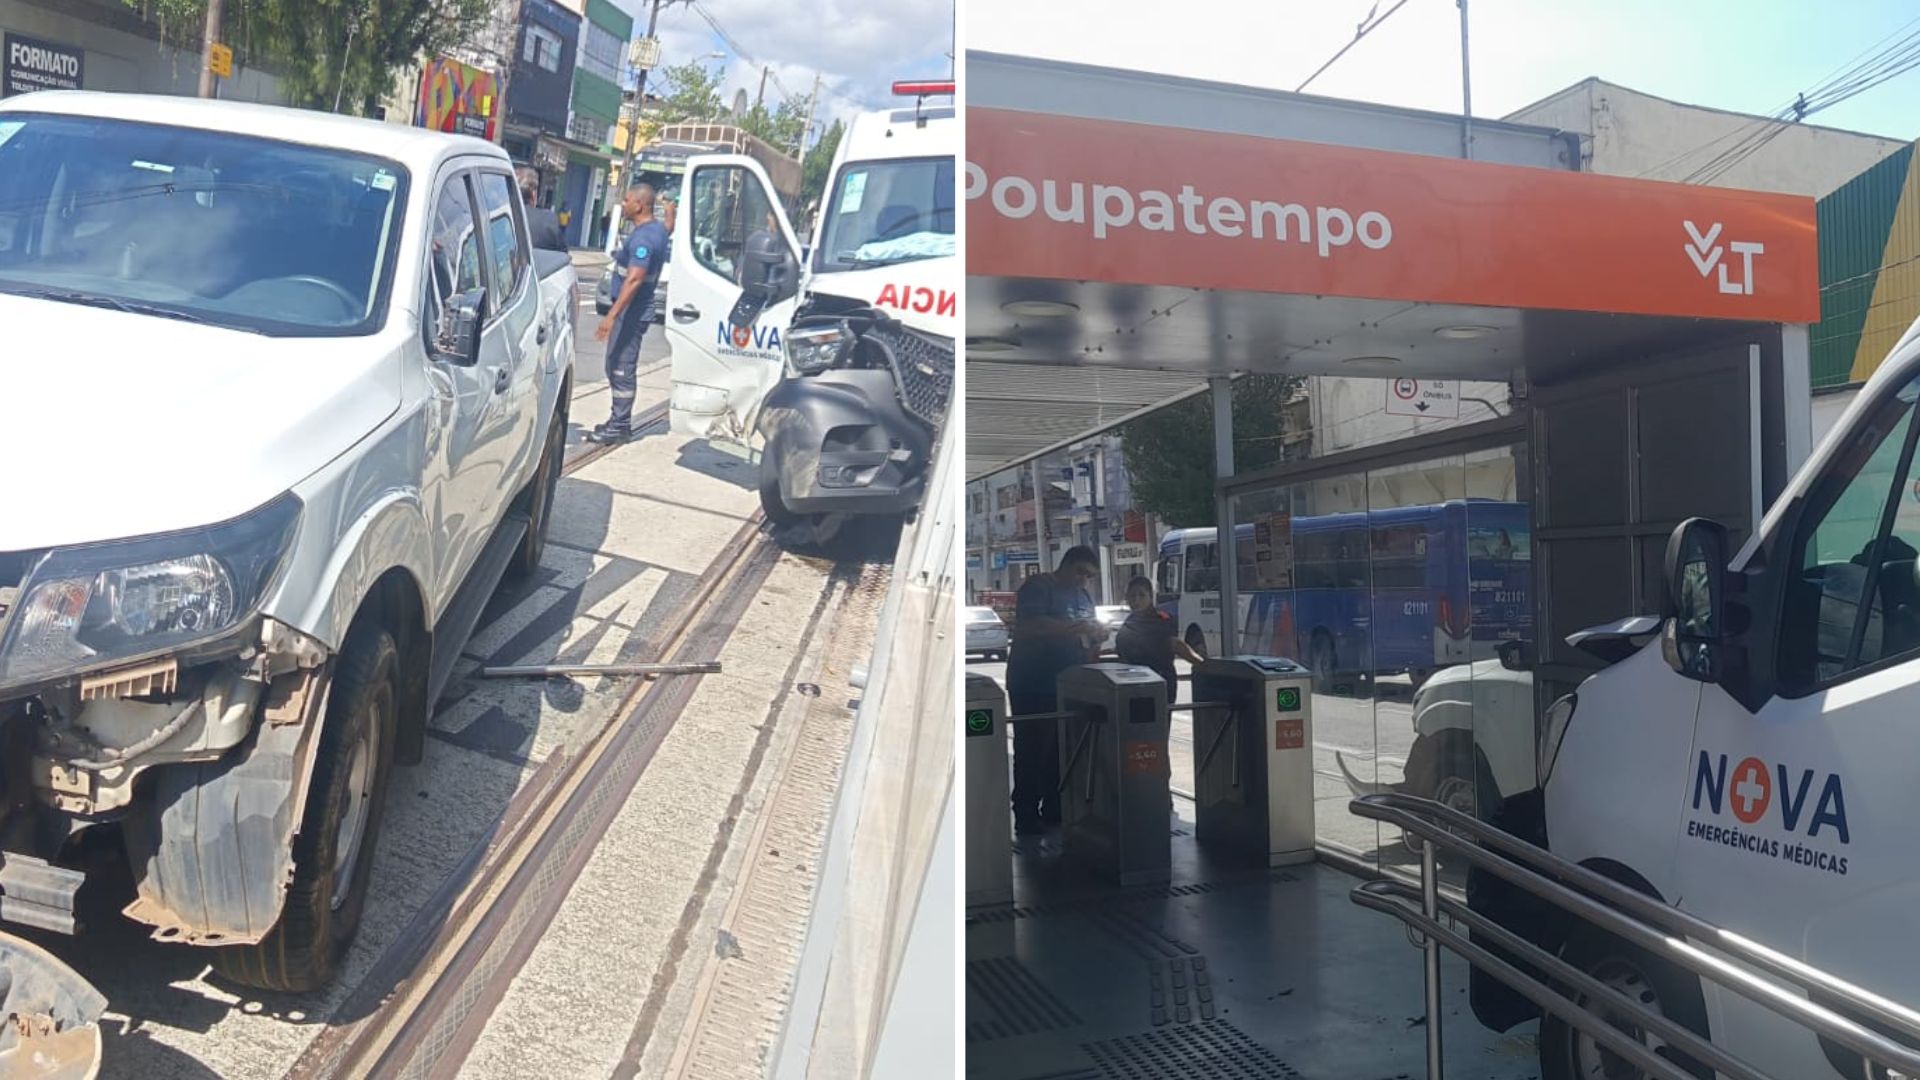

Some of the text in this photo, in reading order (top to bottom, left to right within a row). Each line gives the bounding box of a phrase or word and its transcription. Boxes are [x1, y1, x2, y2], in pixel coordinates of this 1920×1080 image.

[11, 42, 79, 77] FORMATO
[718, 320, 782, 352] NOVA
[1692, 750, 1850, 844] NOVA
[1687, 820, 1848, 876] EMERGÊNCIAS MÉDICAS
